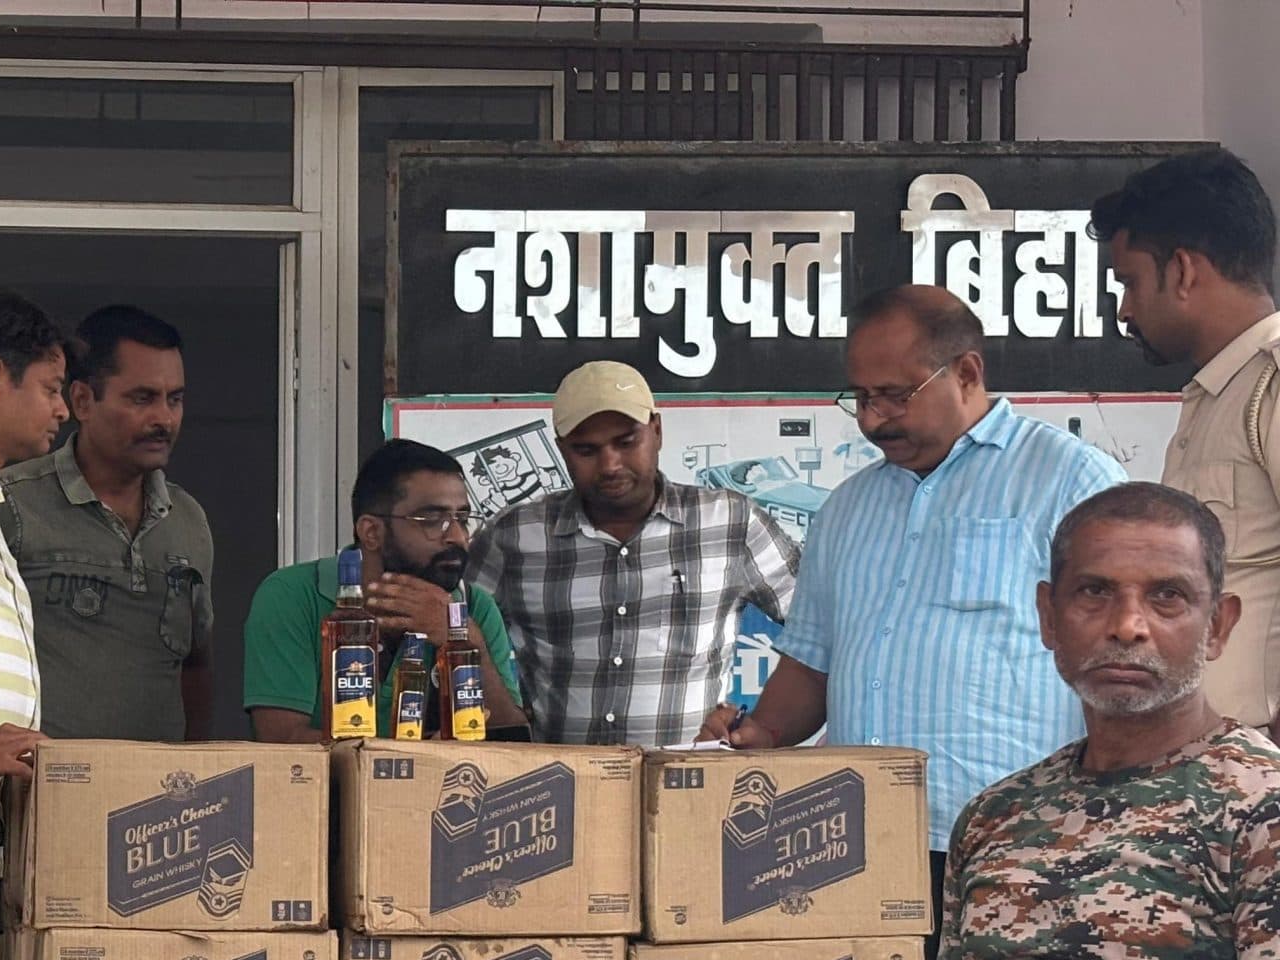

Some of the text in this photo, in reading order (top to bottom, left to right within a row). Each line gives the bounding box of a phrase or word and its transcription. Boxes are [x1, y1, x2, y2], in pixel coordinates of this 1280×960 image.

[445, 208, 855, 378] नशामुक्त
[338, 677, 372, 689] BLUE
[125, 801, 223, 844] Officer's Choice
[485, 805, 556, 854] BLUE
[775, 812, 846, 861] BLUE
[126, 825, 200, 874] BLUE
[462, 835, 556, 878] Officer's Choice
[754, 841, 848, 885] Officer's Choice
